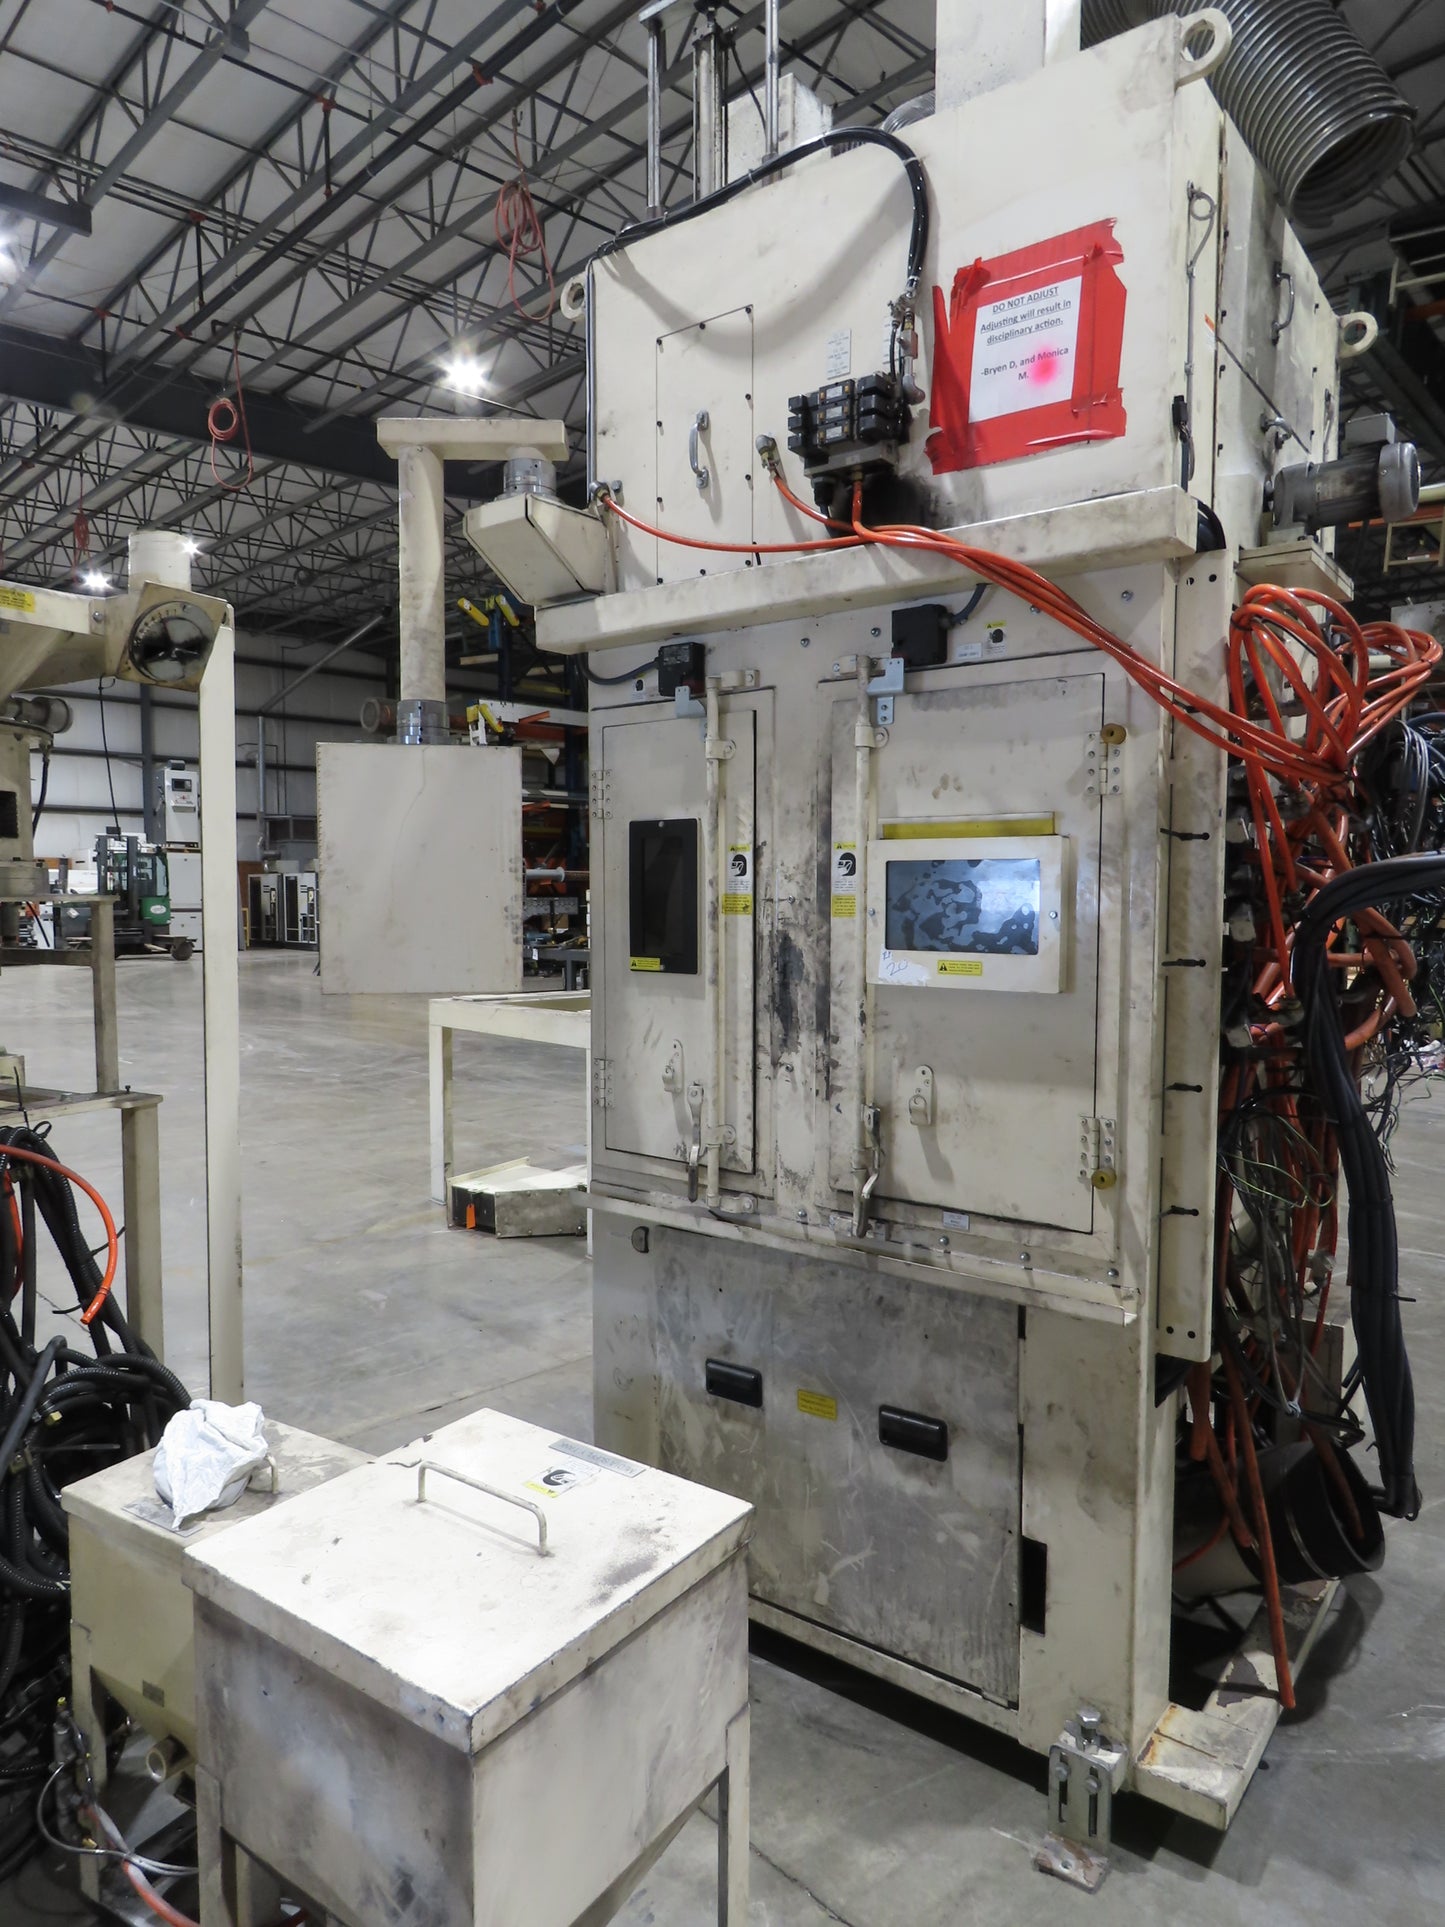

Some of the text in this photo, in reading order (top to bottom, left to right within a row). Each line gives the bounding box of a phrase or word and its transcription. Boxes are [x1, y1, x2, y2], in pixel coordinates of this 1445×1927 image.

[992, 286, 1059, 313] DO NOT ADJUST
[980, 299, 1071, 332] Adjusting will result in
[986, 325, 1033, 345] disciplinary
[1019, 354, 1035, 366] and
[1037, 347, 1069, 360] Monica
[1018, 371, 1029, 380] M.
